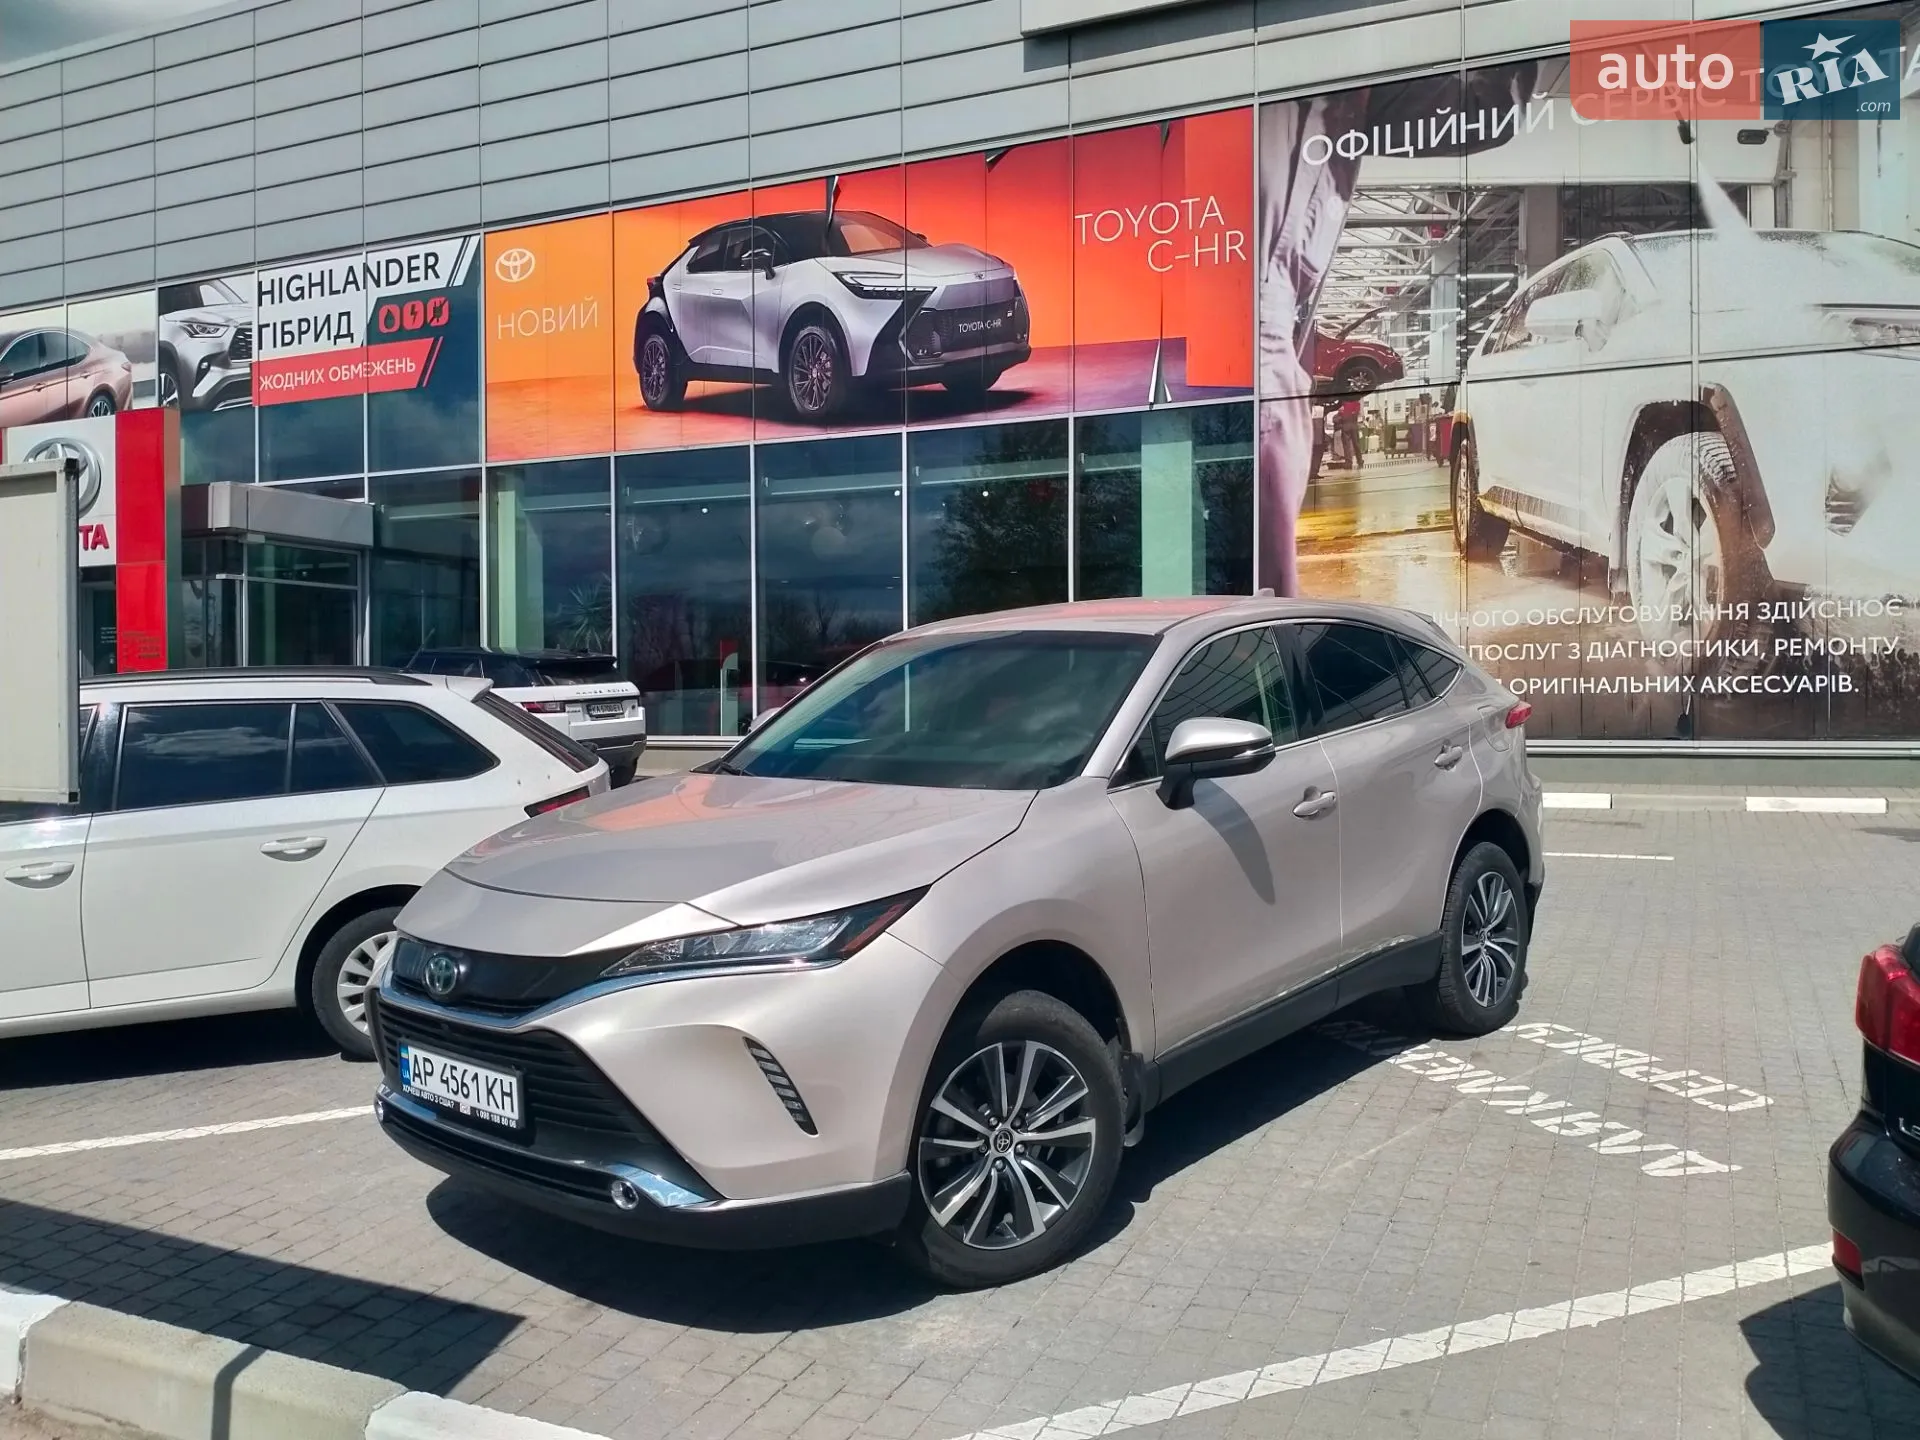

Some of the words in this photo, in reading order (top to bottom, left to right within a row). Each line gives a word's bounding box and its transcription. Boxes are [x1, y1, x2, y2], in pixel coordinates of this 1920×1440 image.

[1302, 92, 1555, 166] ОФІЦІЙНИЙ
[1074, 195, 1225, 245] TOYOTA
[1147, 230, 1247, 272] C-HR
[258, 252, 441, 307] HIGHLANDER
[258, 310, 354, 350] ГІБРИД
[497, 295, 598, 339] НОВИЙ
[259, 367, 324, 391] ЖОДНИХ
[328, 357, 416, 380] ОБМЕЖЕНЬ
[1527, 602, 1749, 626] ОБСЛУГОВУВАННЯ
[1757, 597, 1904, 623] ЗДІЙСНЮЄ
[1468, 642, 1563, 661] ПОСЛУГ
[1567, 642, 1581, 660] З
[1586, 638, 1766, 663] ДІАГНОСТИКИ,
[1775, 636, 1900, 657] РЕМОНТУ
[1509, 675, 1696, 695] ОРИГІНАЛЬНИХ
[1699, 674, 1859, 694] АКСЕСУАРІВ.
[412, 1053, 434, 1087] AP
[440, 1062, 481, 1104] 4561
[485, 1075, 515, 1113] KH
